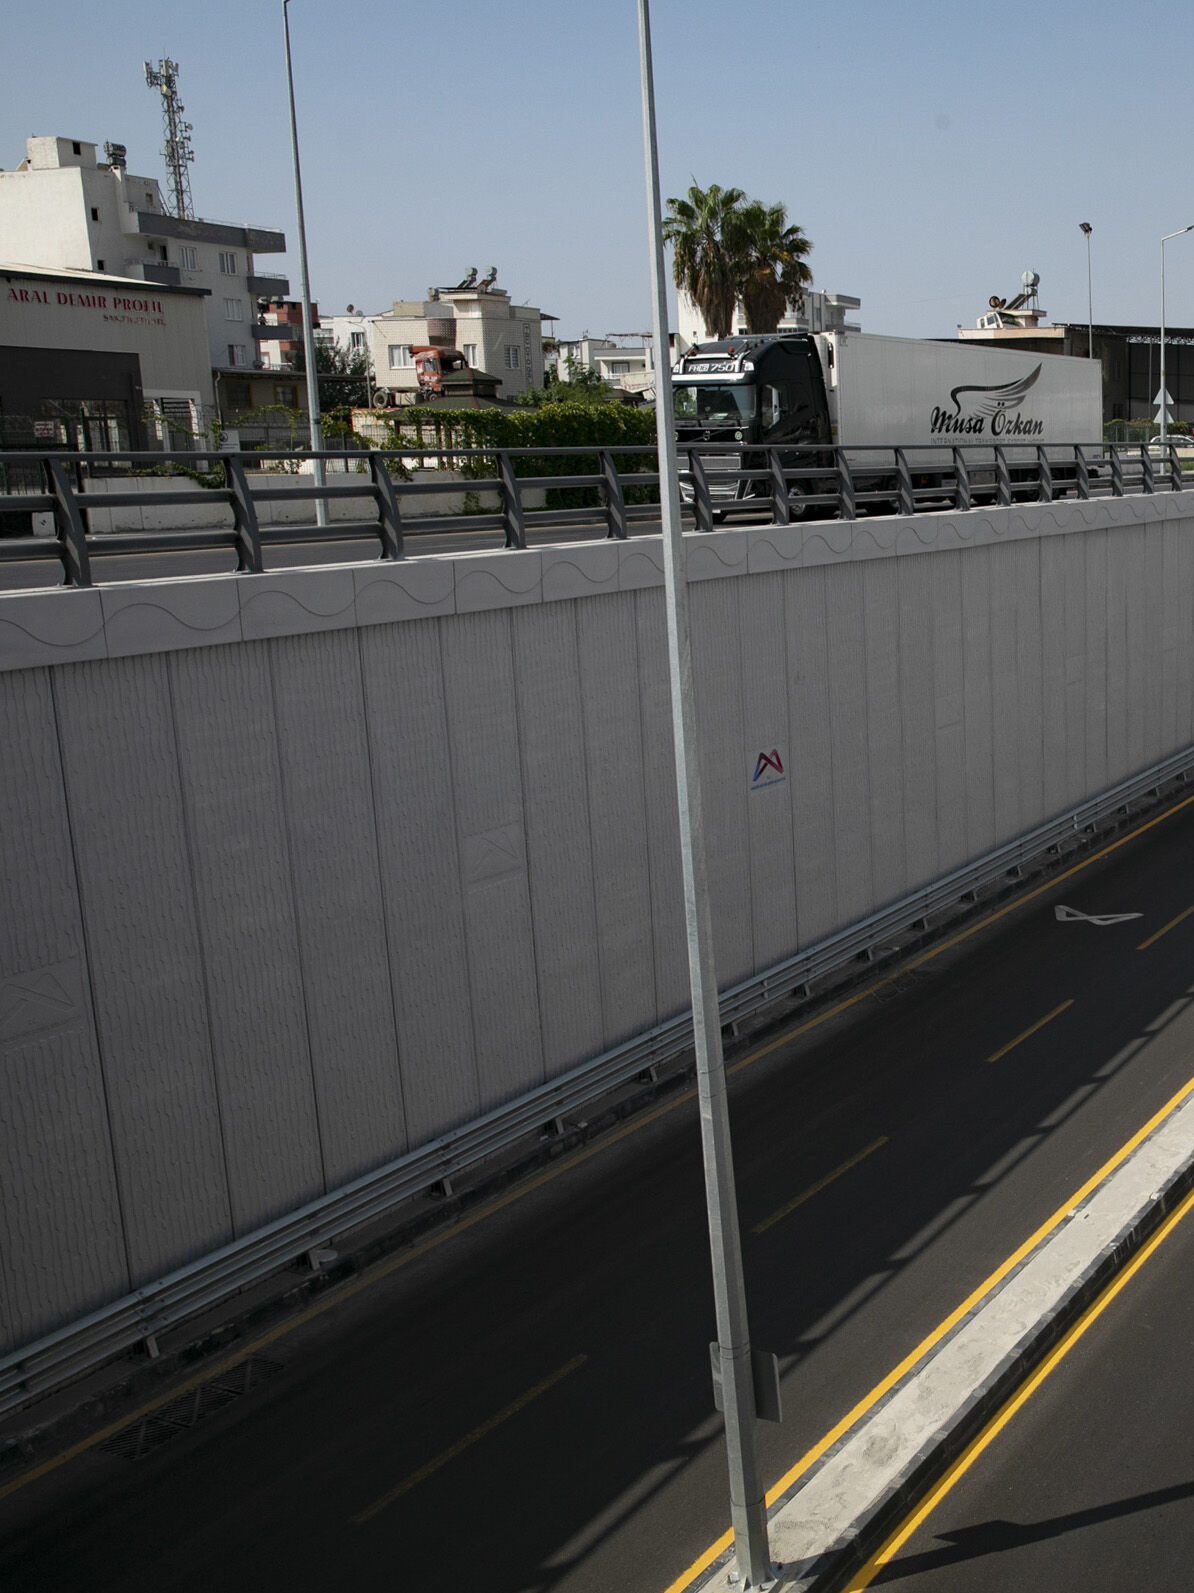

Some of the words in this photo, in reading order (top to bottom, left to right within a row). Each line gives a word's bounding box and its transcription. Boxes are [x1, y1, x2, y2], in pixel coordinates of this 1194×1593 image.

[8, 288, 50, 304] ARAL
[711, 363, 734, 372] 750
[930, 406, 985, 434] Musa
[990, 401, 1044, 436] Özkan
